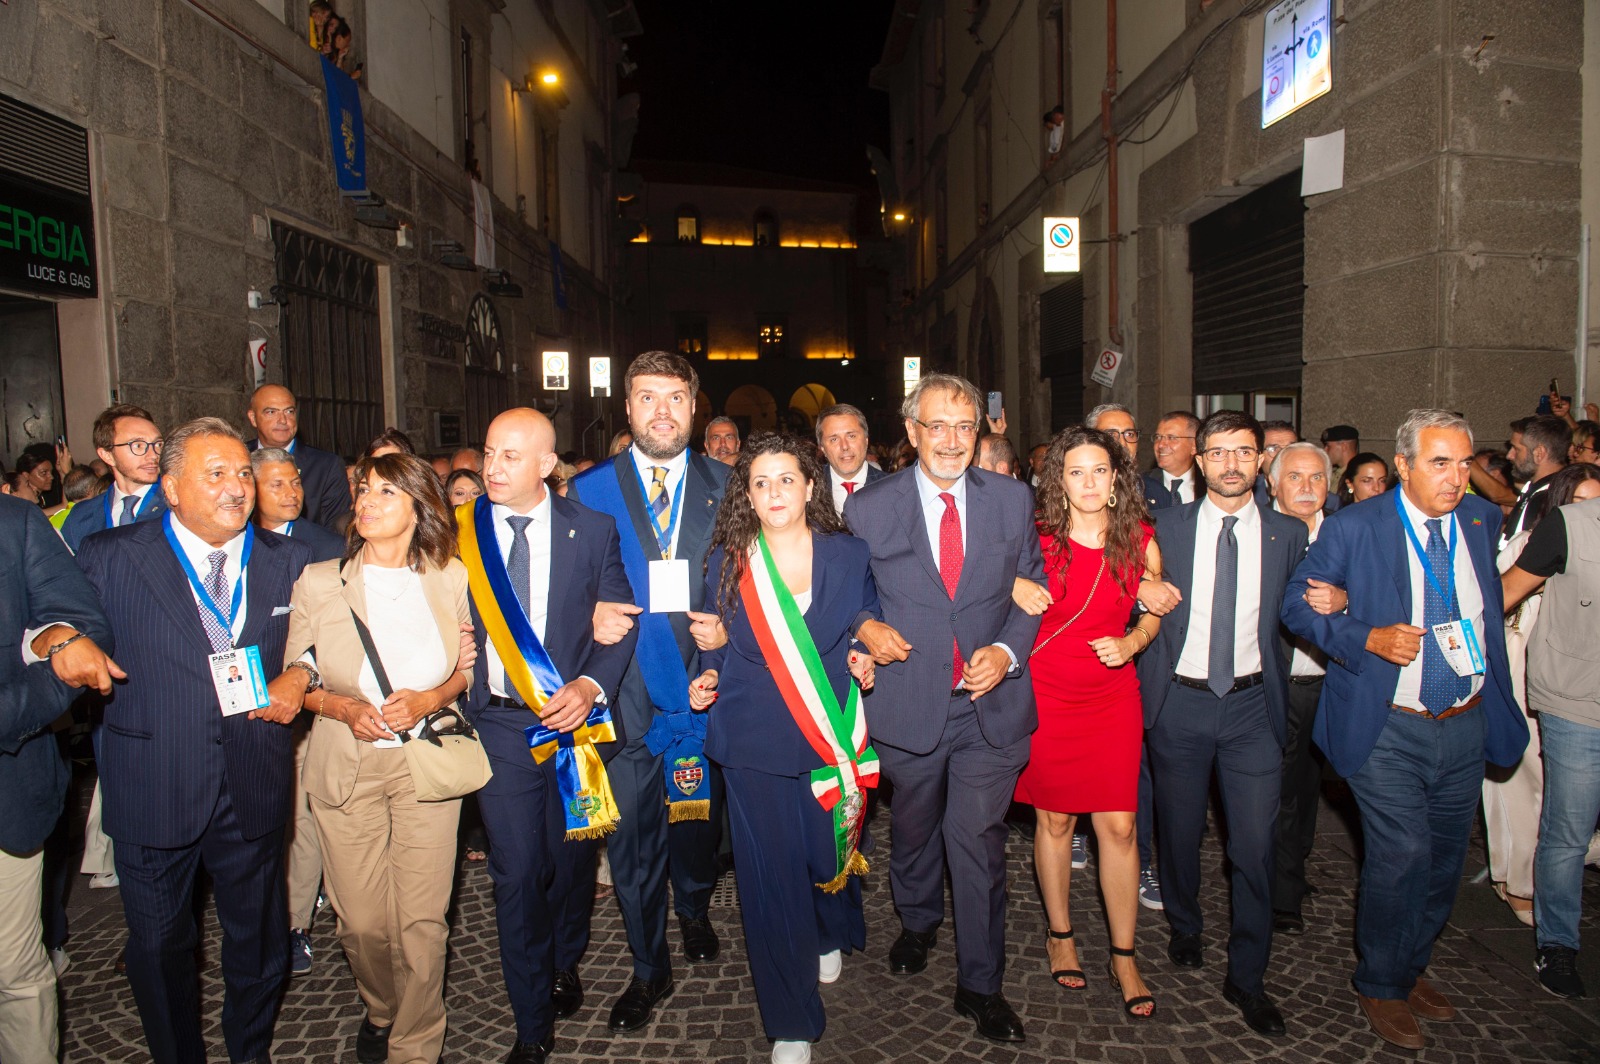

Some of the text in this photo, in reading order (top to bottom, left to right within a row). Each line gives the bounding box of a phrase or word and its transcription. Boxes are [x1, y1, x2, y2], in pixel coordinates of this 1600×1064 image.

[1312, 15, 1326, 28] Roma
[28, 263, 91, 289] LUCE & GAS
[1435, 624, 1453, 632] PASS
[212, 652, 236, 661] PASS
